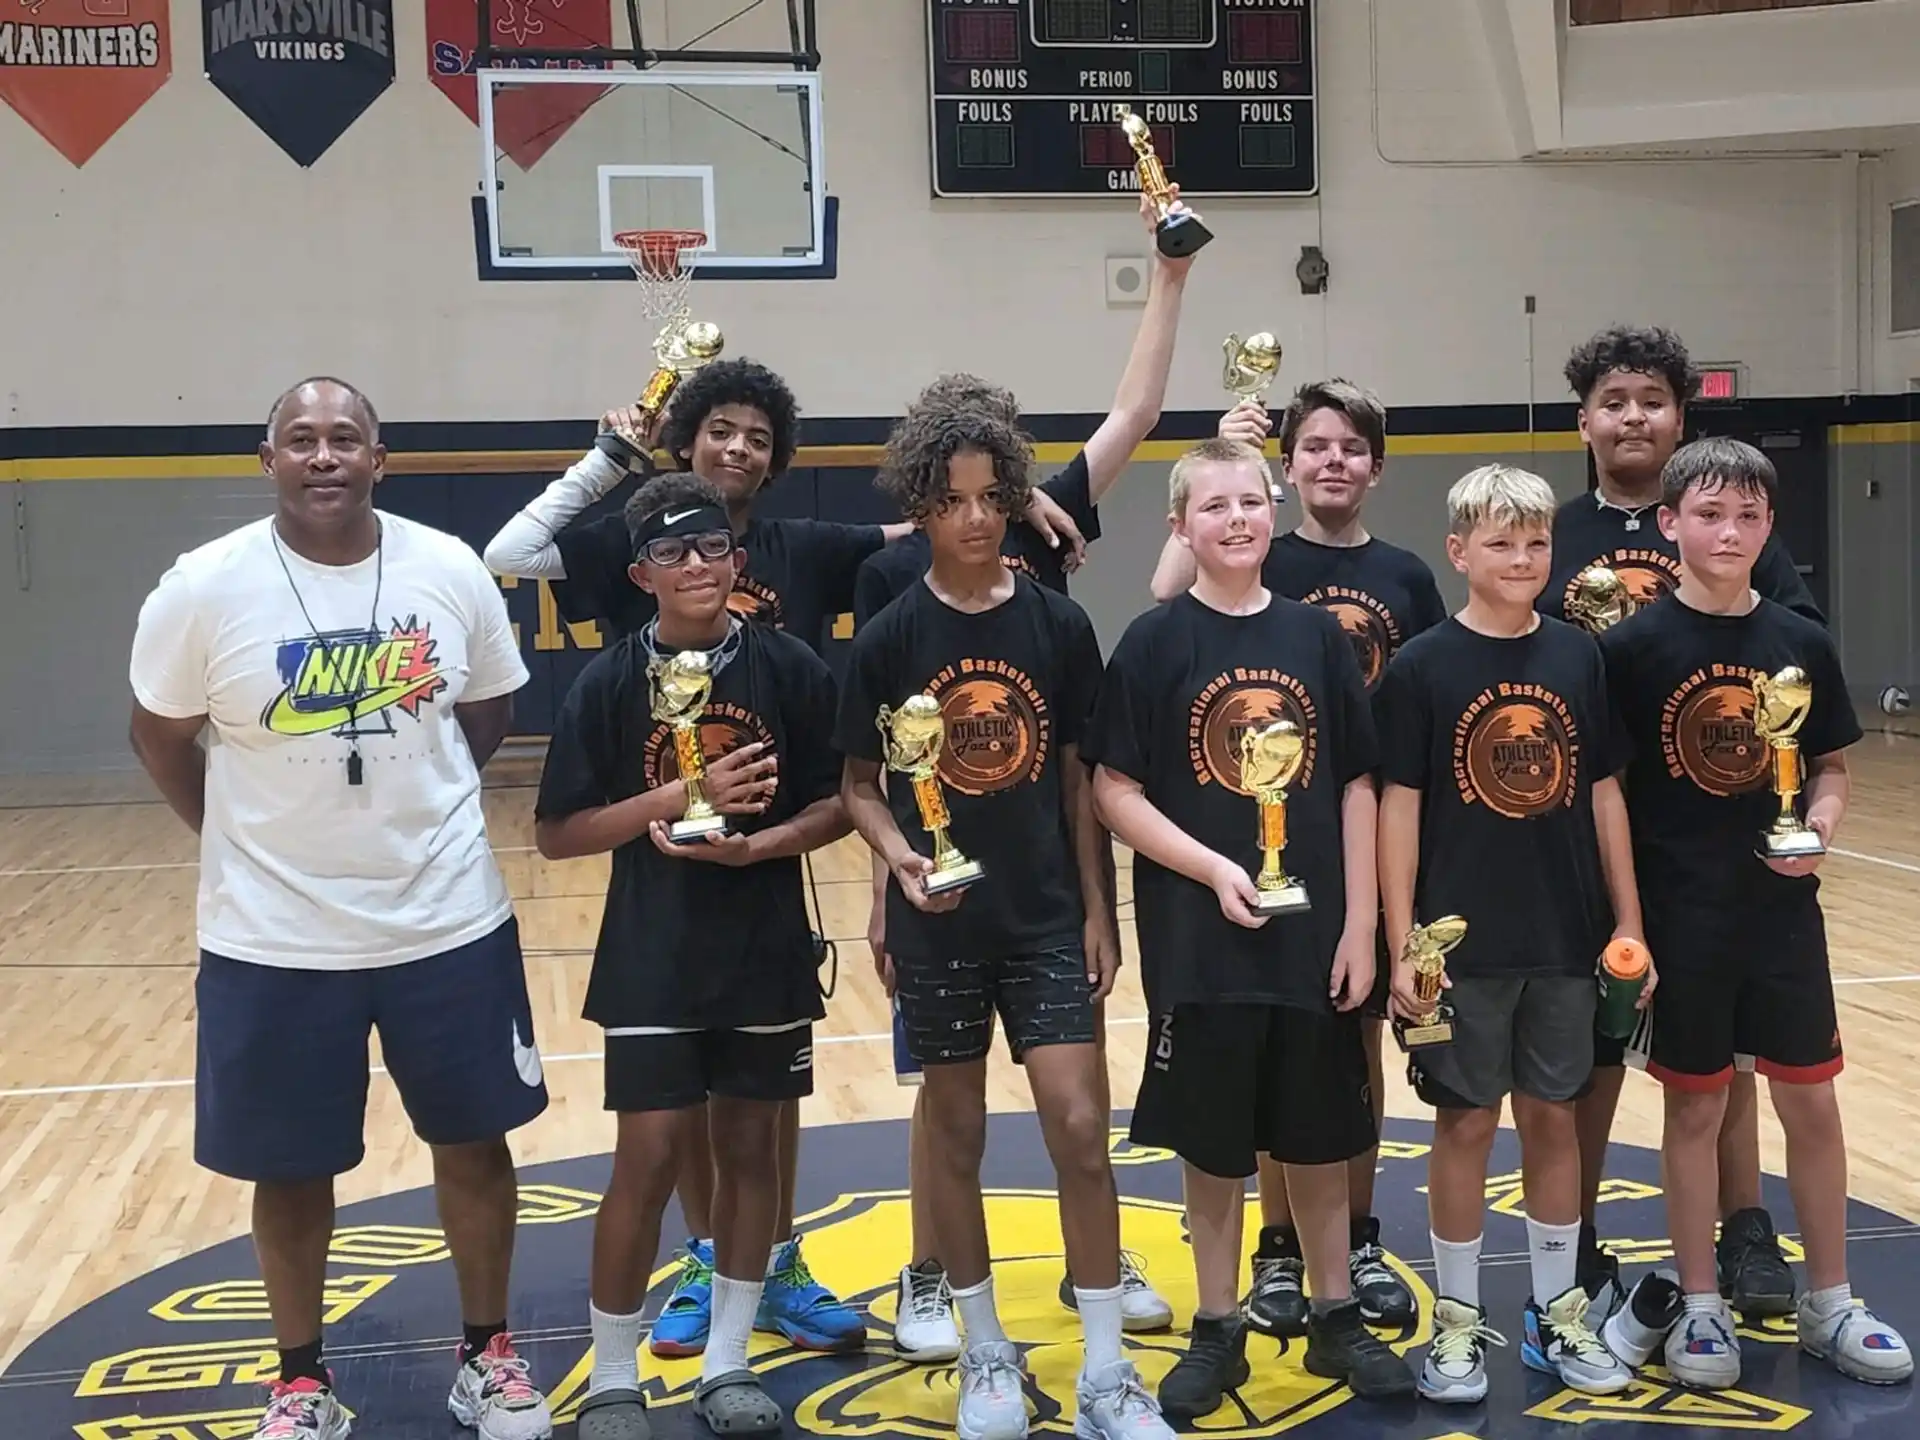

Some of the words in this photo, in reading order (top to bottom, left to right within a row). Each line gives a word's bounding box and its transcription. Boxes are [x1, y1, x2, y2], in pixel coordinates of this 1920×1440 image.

[0, 21, 160, 68] MARINERS
[254, 40, 346, 61] VIKINGS
[970, 68, 1028, 89] BONUS
[1079, 70, 1133, 88] PERIOD
[1222, 69, 1279, 90] BONUS
[958, 101, 1012, 122] FOULS
[1145, 102, 1199, 122] FOULS
[1240, 102, 1293, 122] FOULS
[1107, 169, 1142, 190] GAM
[295, 640, 416, 697] NIKE
[959, 657, 1048, 715] Basketball
[1498, 682, 1578, 738] Basketball
[951, 719, 1013, 740] ATHLETIC
